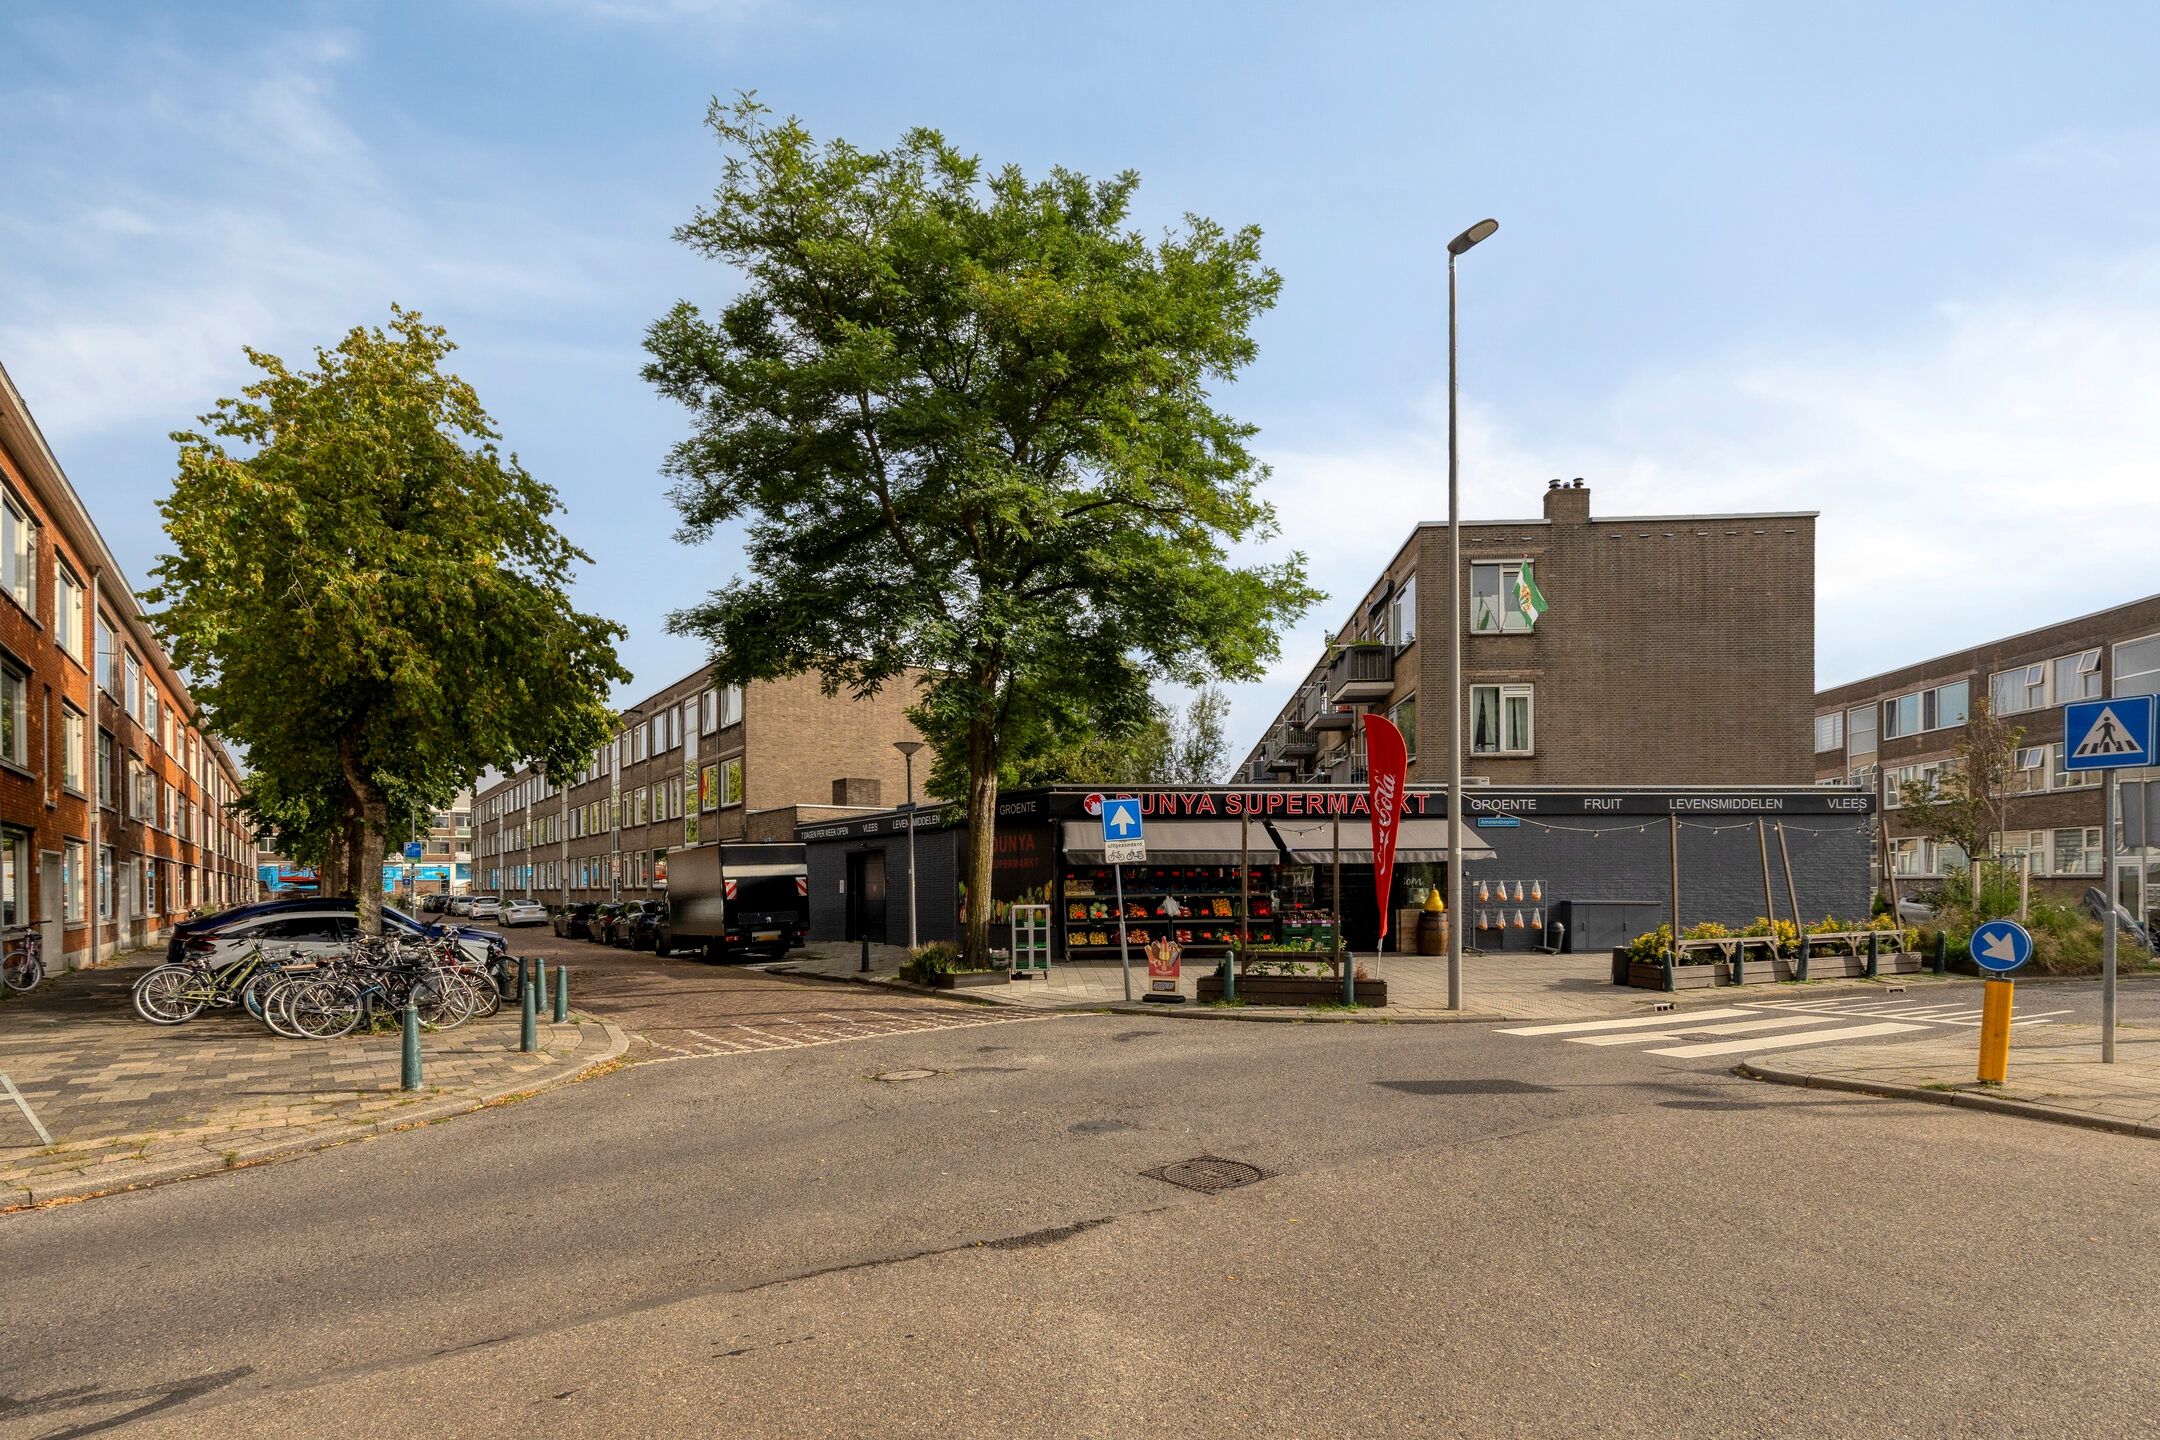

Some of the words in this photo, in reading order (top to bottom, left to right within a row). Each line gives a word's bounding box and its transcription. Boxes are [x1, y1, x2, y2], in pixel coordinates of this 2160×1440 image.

[999, 801, 1037, 815] GROENTE
[1225, 792, 1430, 815] SUPERMAKT
[1471, 799, 1537, 810] GROENTE
[1584, 798, 1623, 810] FRUIT
[1669, 798, 1783, 809] LEVENSMIDDELEN
[1827, 798, 1867, 809] VLEES
[862, 822, 879, 833] VLEES
[892, 814, 941, 829] LEVENMIDDELEN
[804, 830, 817, 839] DAGEN
[817, 829, 825, 838] PER
[825, 828, 836, 837] WEEK
[837, 826, 849, 836] OPEN
